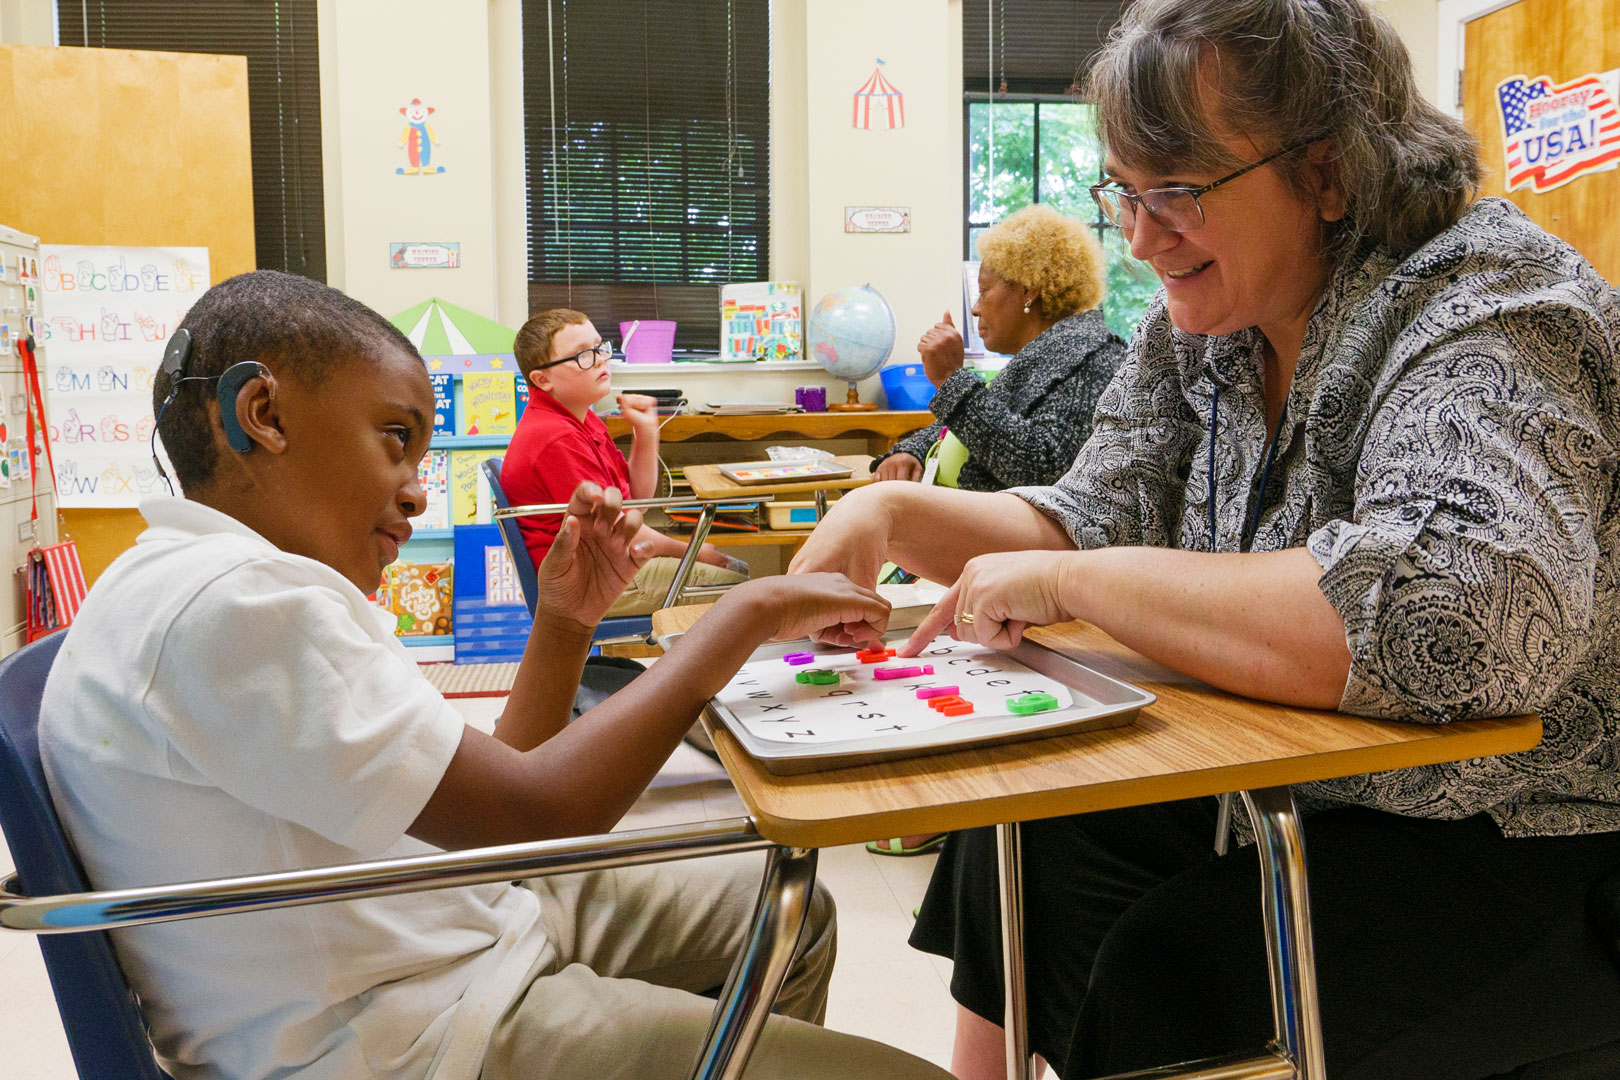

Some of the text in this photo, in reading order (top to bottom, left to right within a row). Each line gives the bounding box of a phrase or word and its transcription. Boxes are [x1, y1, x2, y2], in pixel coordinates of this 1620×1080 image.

[1529, 89, 1590, 119] Hooray
[1524, 119, 1595, 164] USA!
[60, 273, 76, 291] B
[91, 273, 107, 291] C
[124, 274, 140, 291] D
[156, 274, 170, 291] E
[80, 323, 96, 341] H
[117, 323, 132, 340] I
[71, 373, 90, 390] M
[112, 373, 128, 390] N
[471, 392, 512, 408] WEDNESDAY
[80, 424, 96, 442] R
[114, 424, 130, 442] S
[75, 476, 98, 494] W
[118, 475, 133, 494] X
